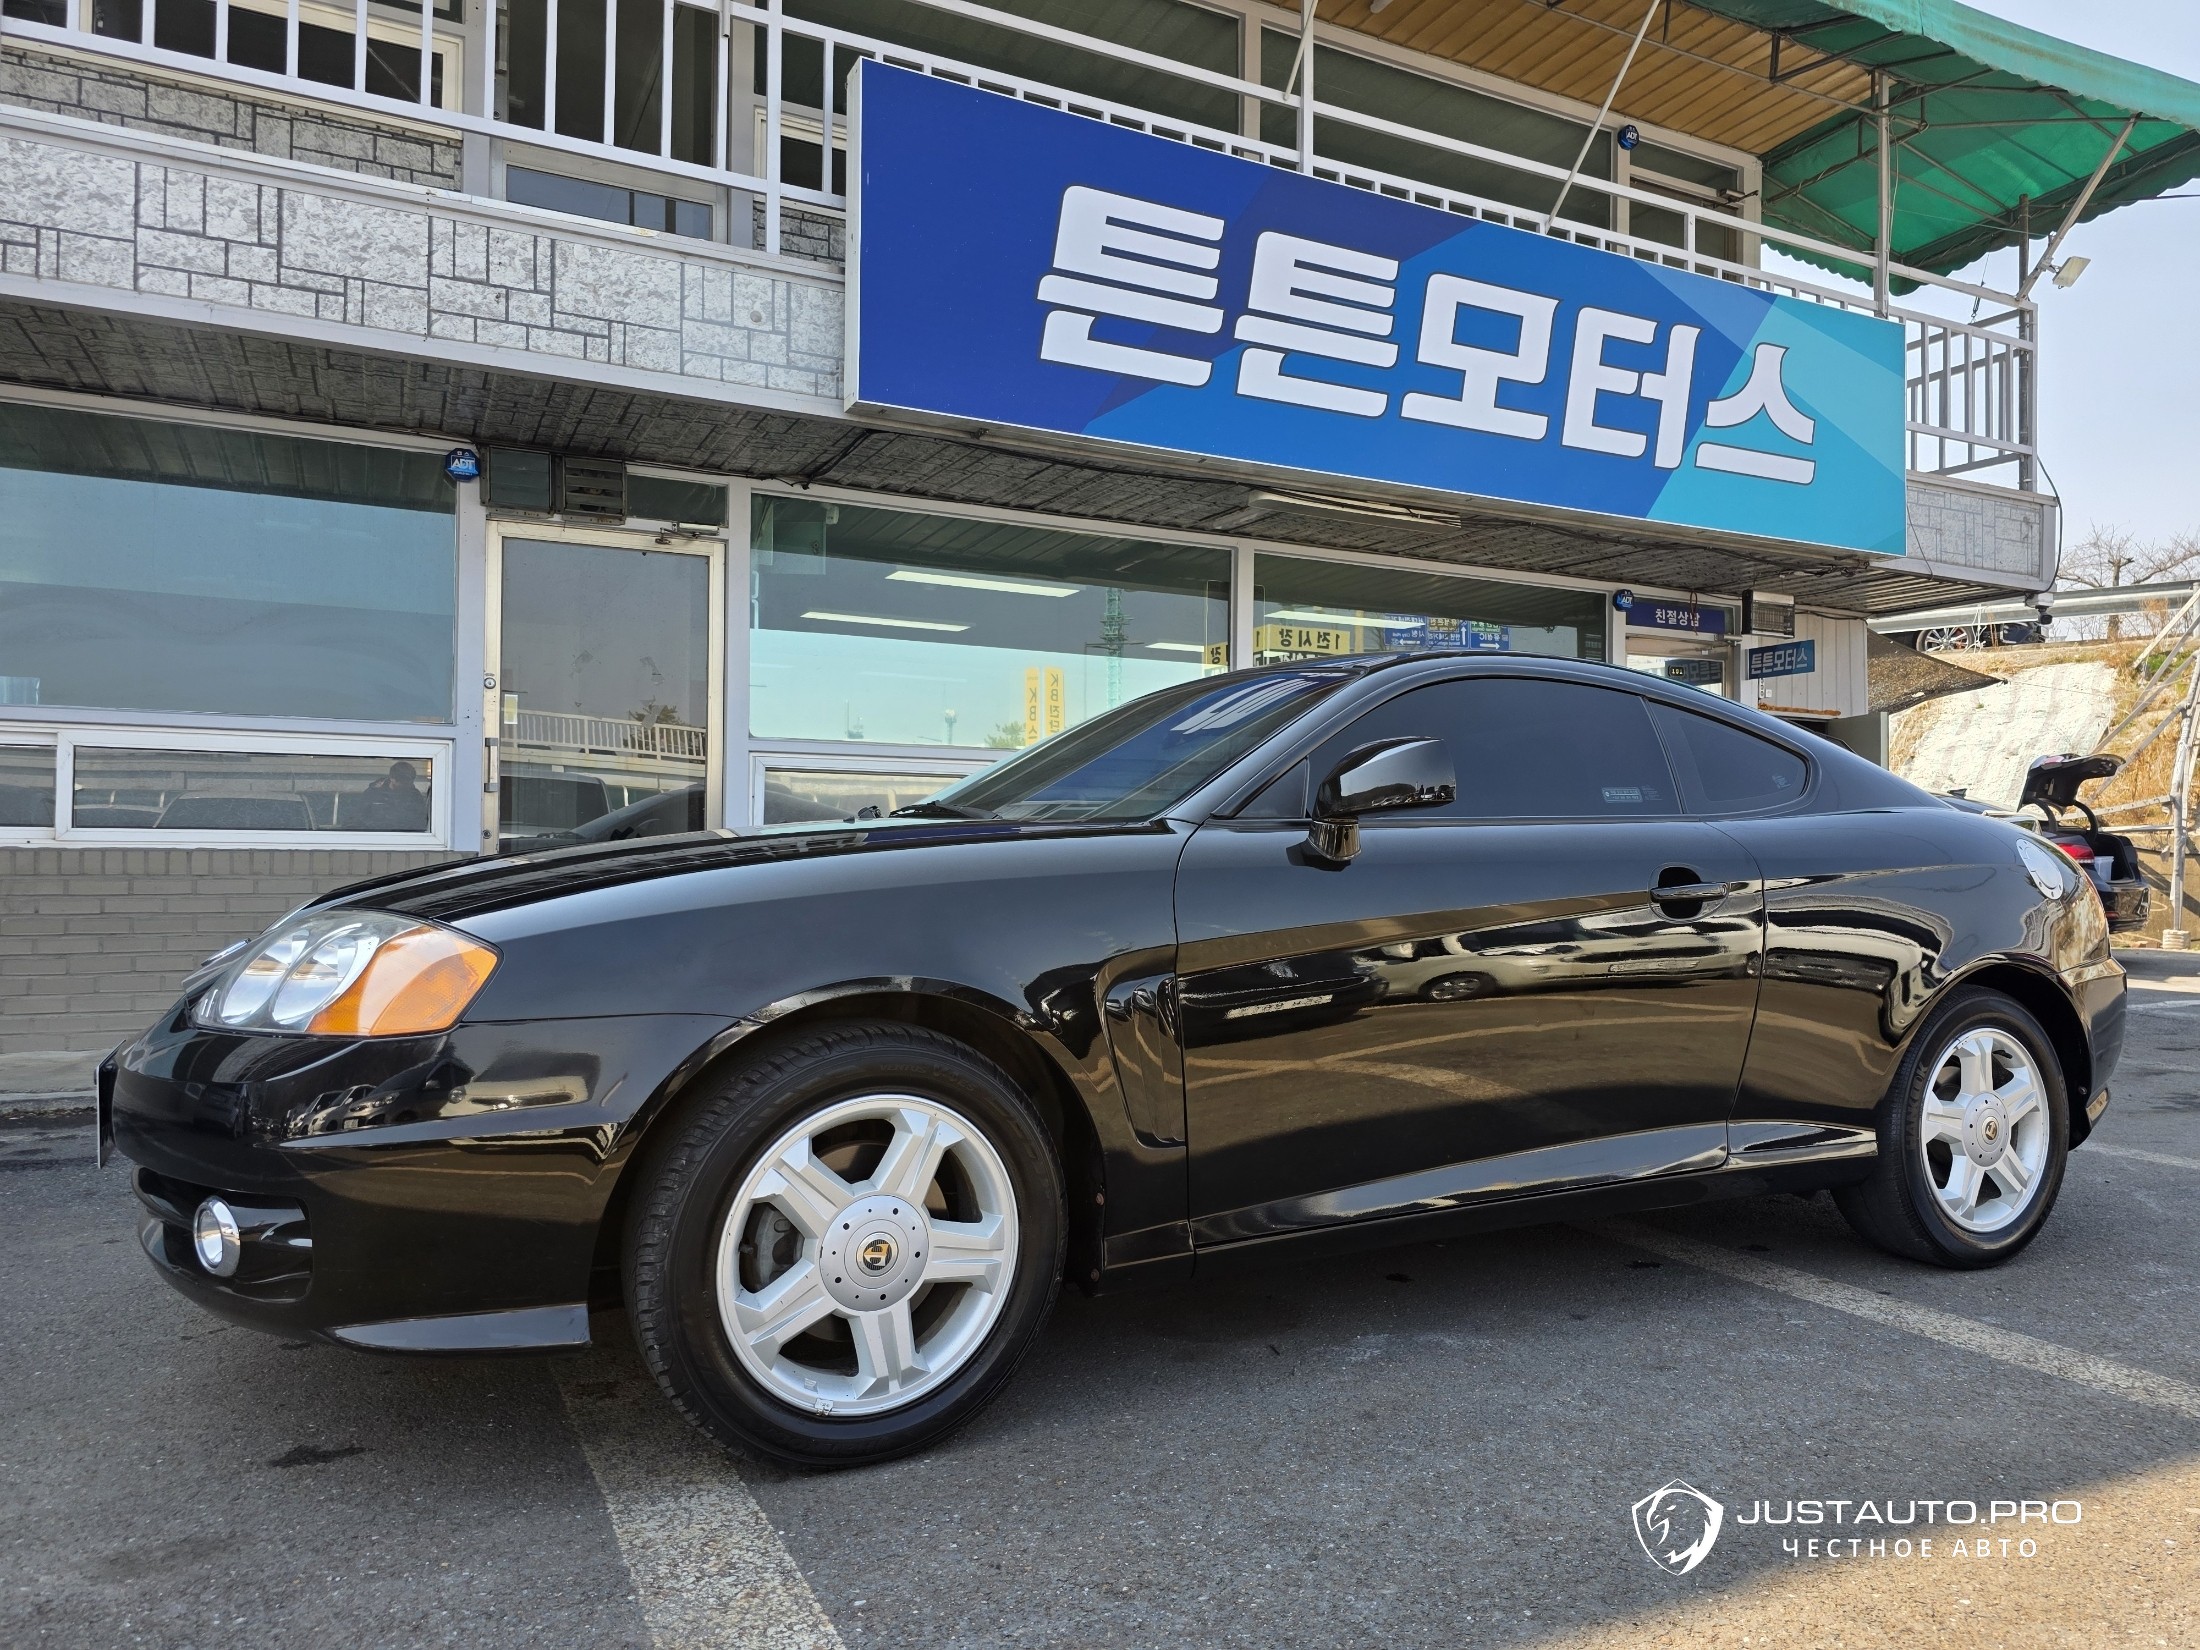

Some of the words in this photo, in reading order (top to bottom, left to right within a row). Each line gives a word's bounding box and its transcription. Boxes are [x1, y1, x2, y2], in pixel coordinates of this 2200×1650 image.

[1037, 185, 1816, 486] 튼튼모터스
[452, 458, 475, 471] ADT
[1655, 608, 1701, 627] 친절상담
[1751, 647, 1808, 676] 튼튼모터스
